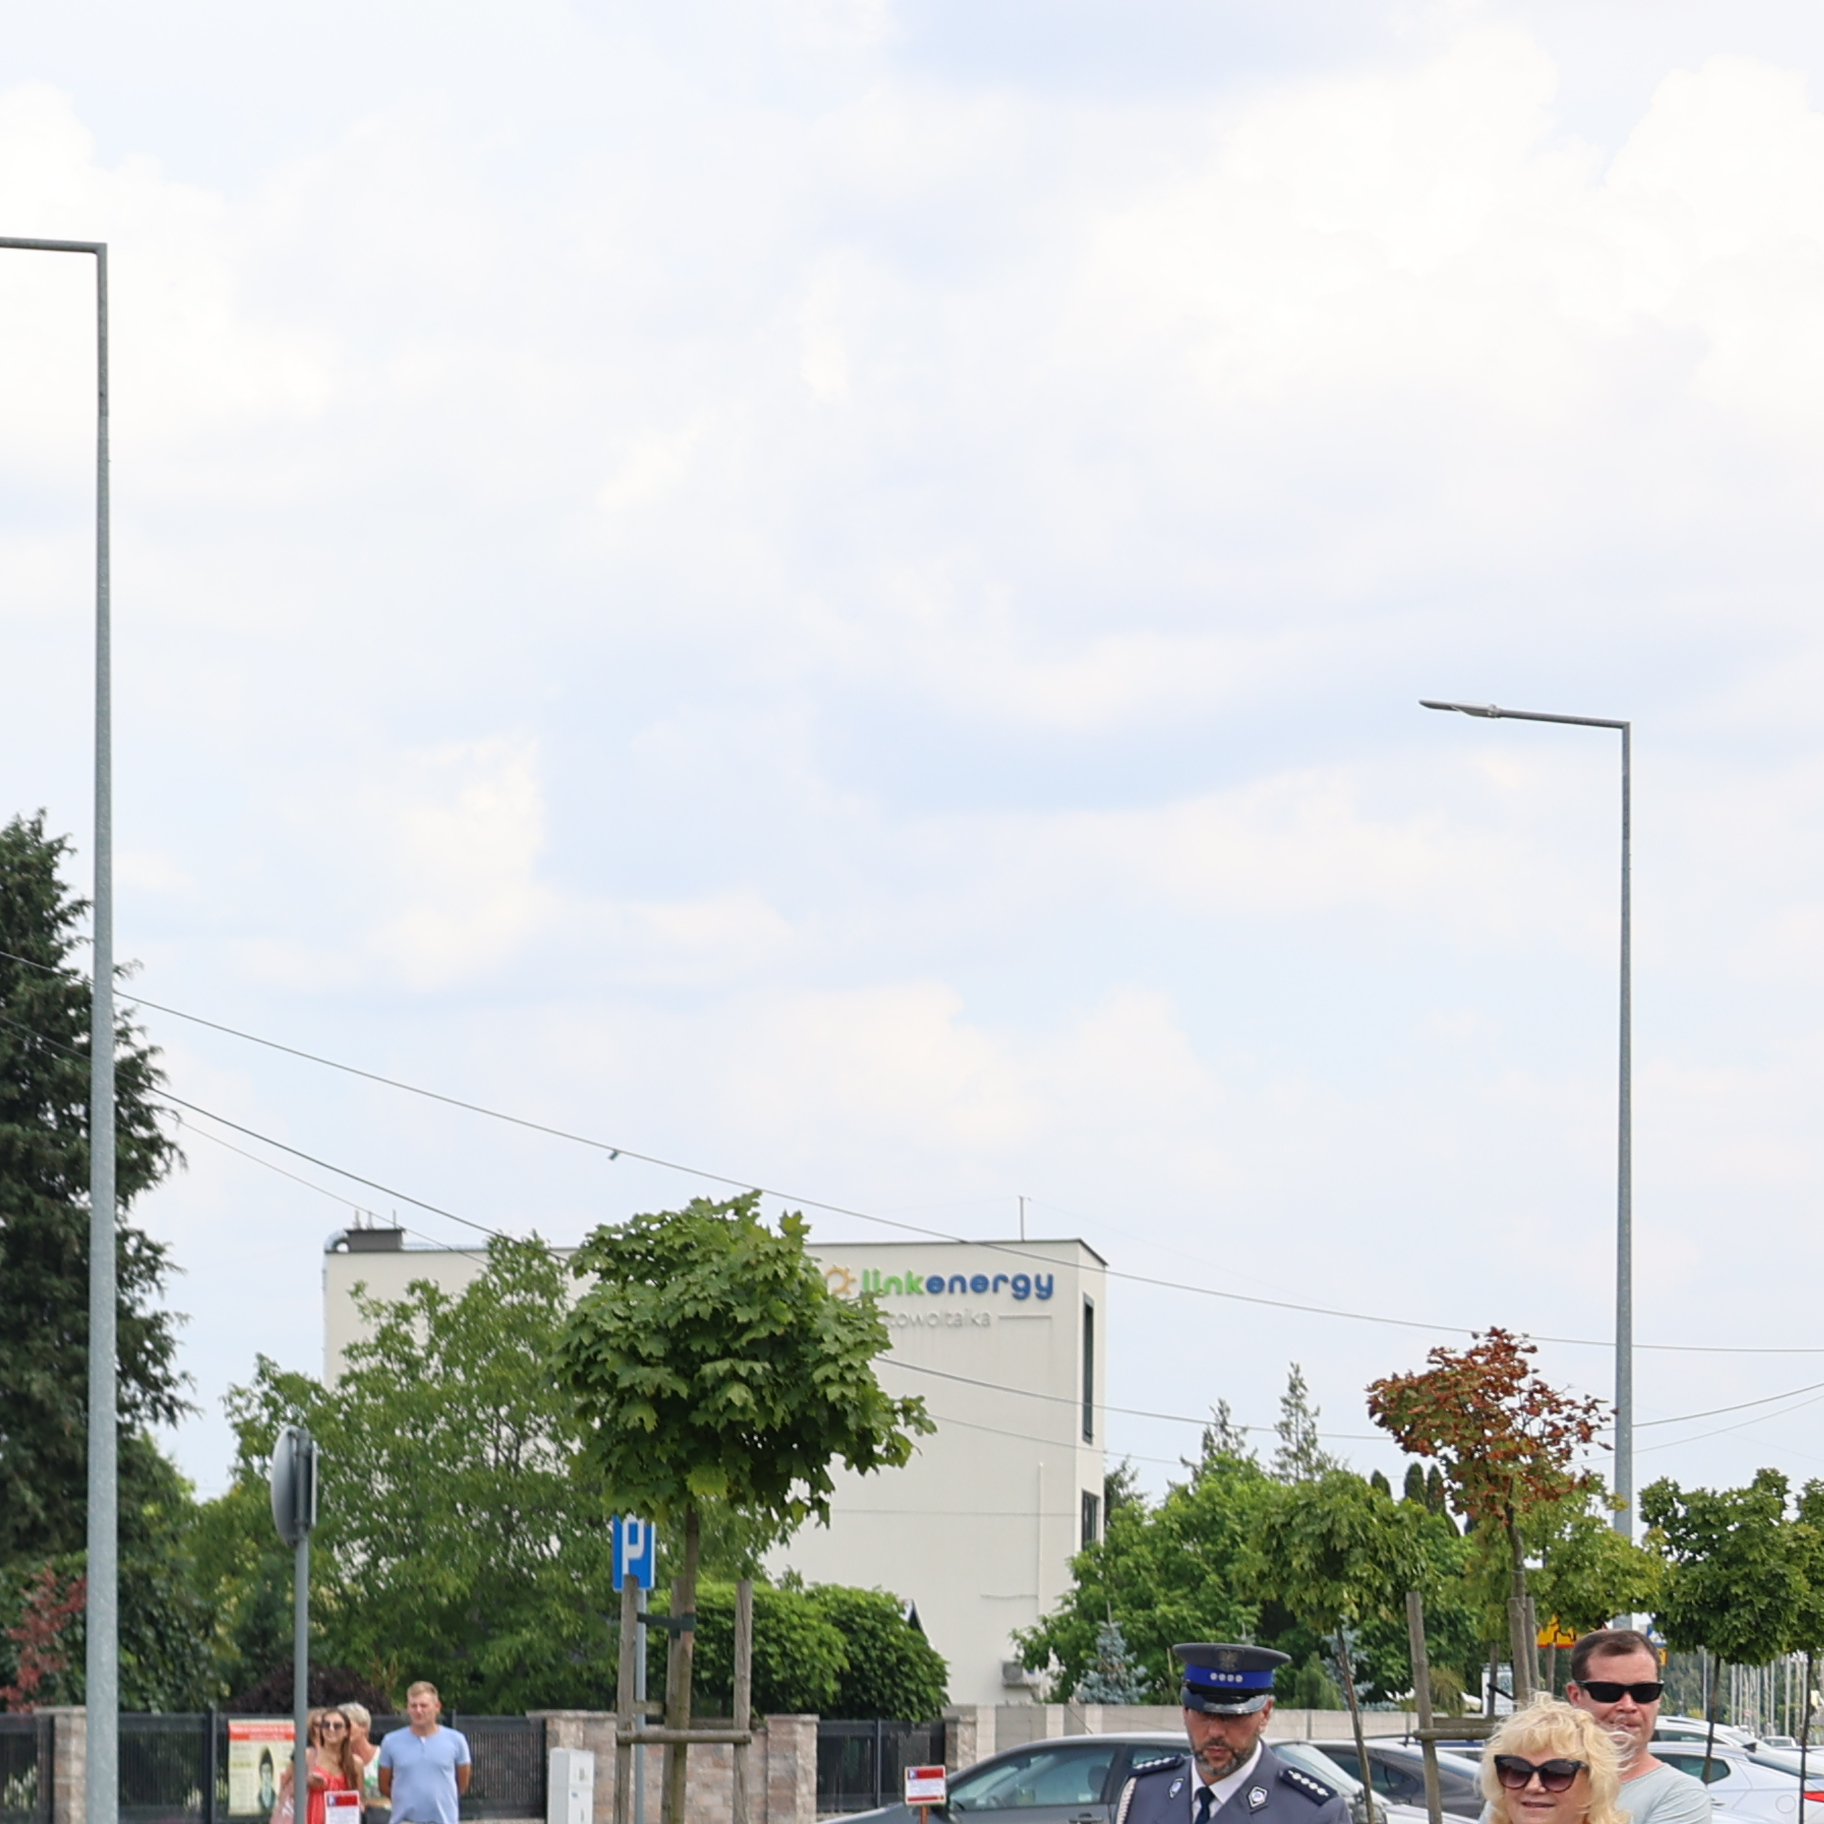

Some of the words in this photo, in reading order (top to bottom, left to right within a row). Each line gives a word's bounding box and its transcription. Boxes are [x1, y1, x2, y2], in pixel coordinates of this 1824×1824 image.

[862, 1268, 1054, 1301] linkenergy
[887, 1308, 992, 1328] towoltaika
[622, 1514, 645, 1574] P
